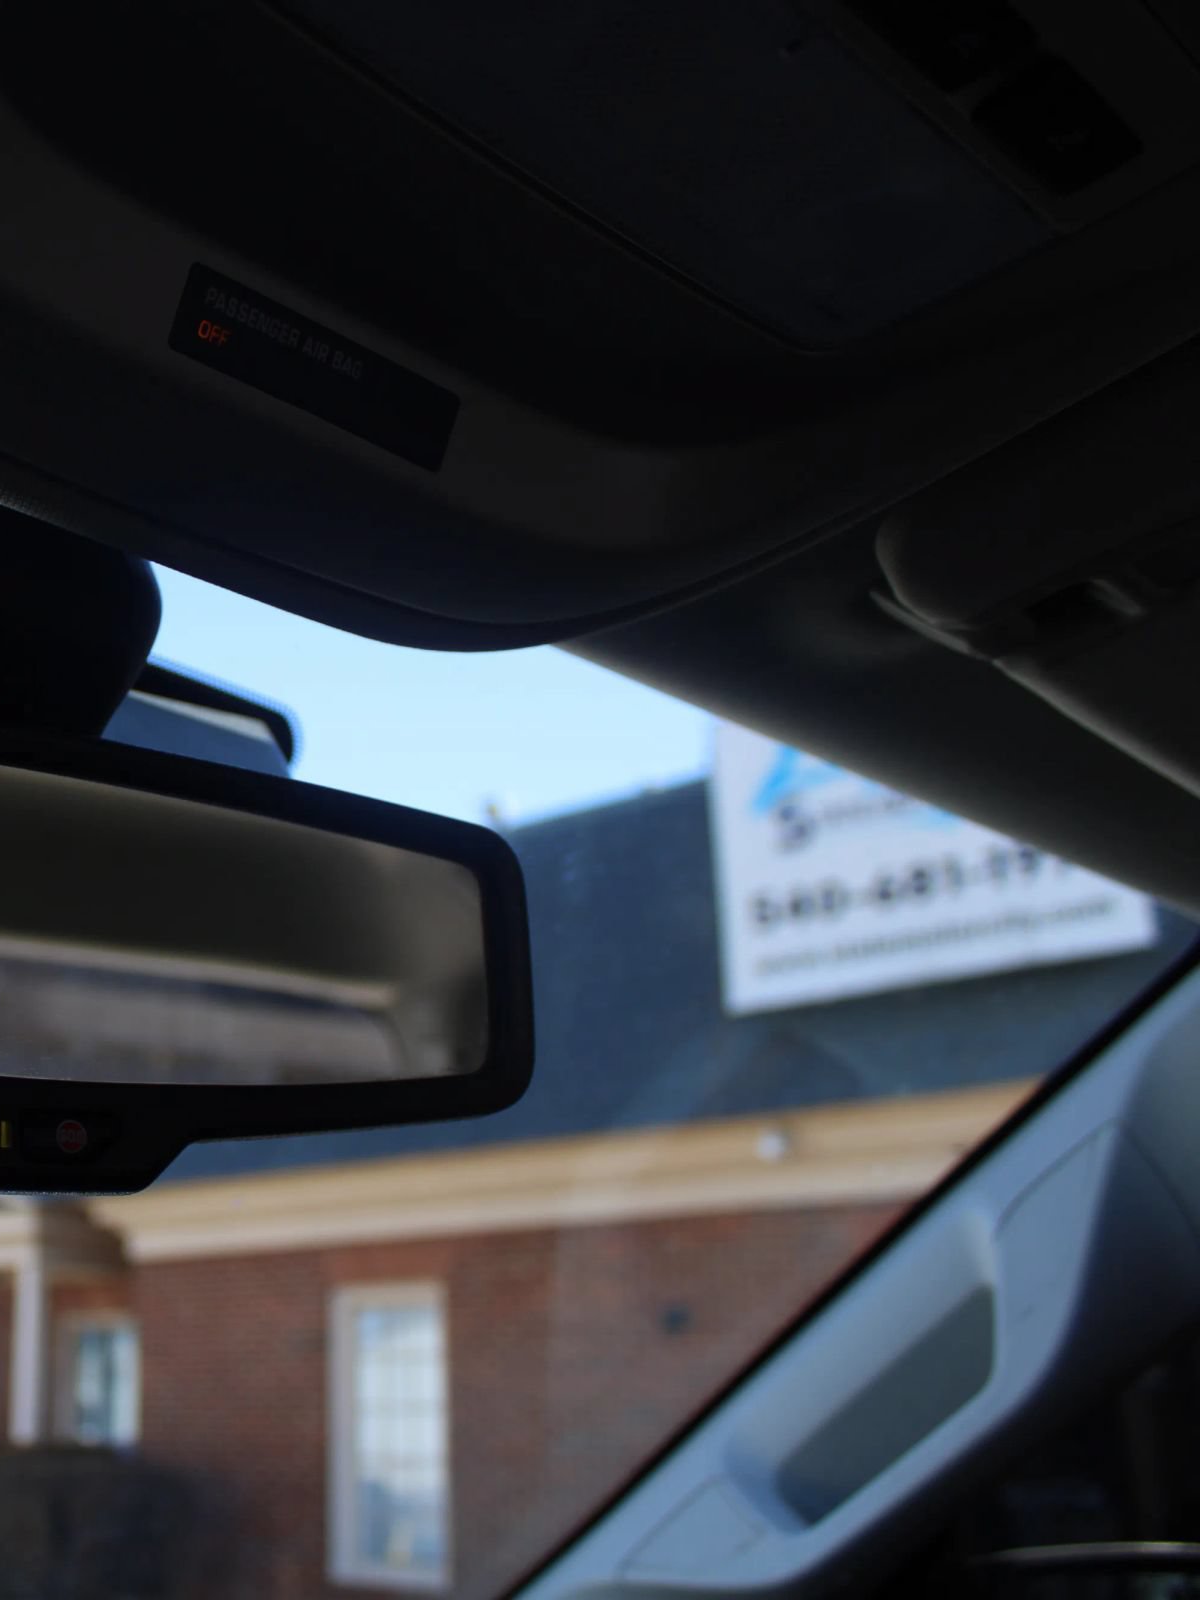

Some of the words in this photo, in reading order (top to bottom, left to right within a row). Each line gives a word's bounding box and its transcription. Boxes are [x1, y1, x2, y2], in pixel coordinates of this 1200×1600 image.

[196, 319, 231, 347] OFF
[204, 287, 302, 348] PASSENGER
[302, 336, 330, 364] AIR
[332, 349, 365, 380] BAG
